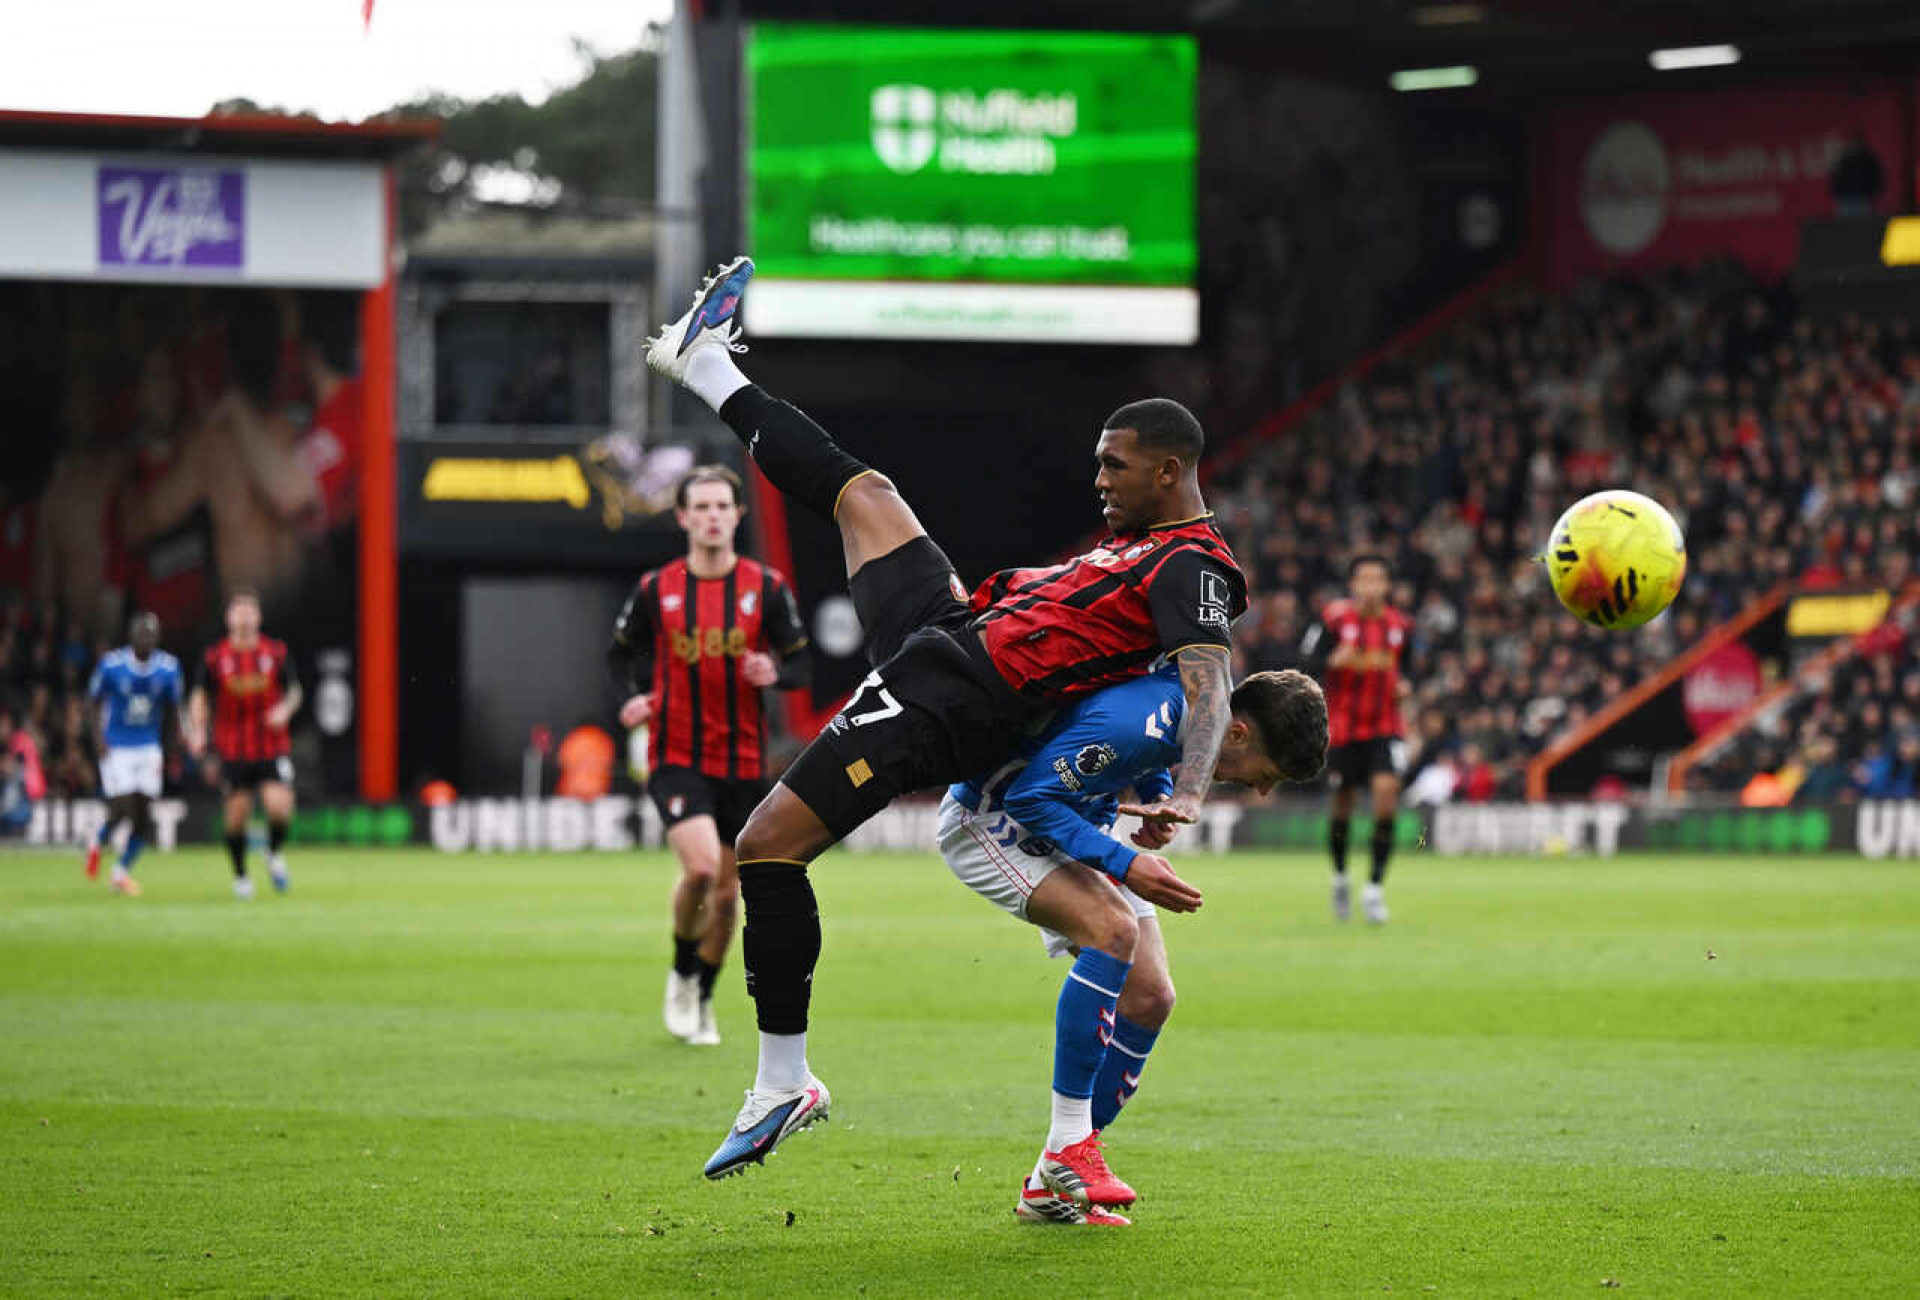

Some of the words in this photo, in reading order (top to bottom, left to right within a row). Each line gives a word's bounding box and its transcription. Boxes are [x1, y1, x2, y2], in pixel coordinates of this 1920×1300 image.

[939, 88, 1078, 138] Nuffield
[938, 137, 1057, 176] Health
[808, 215, 957, 257] Healthcare
